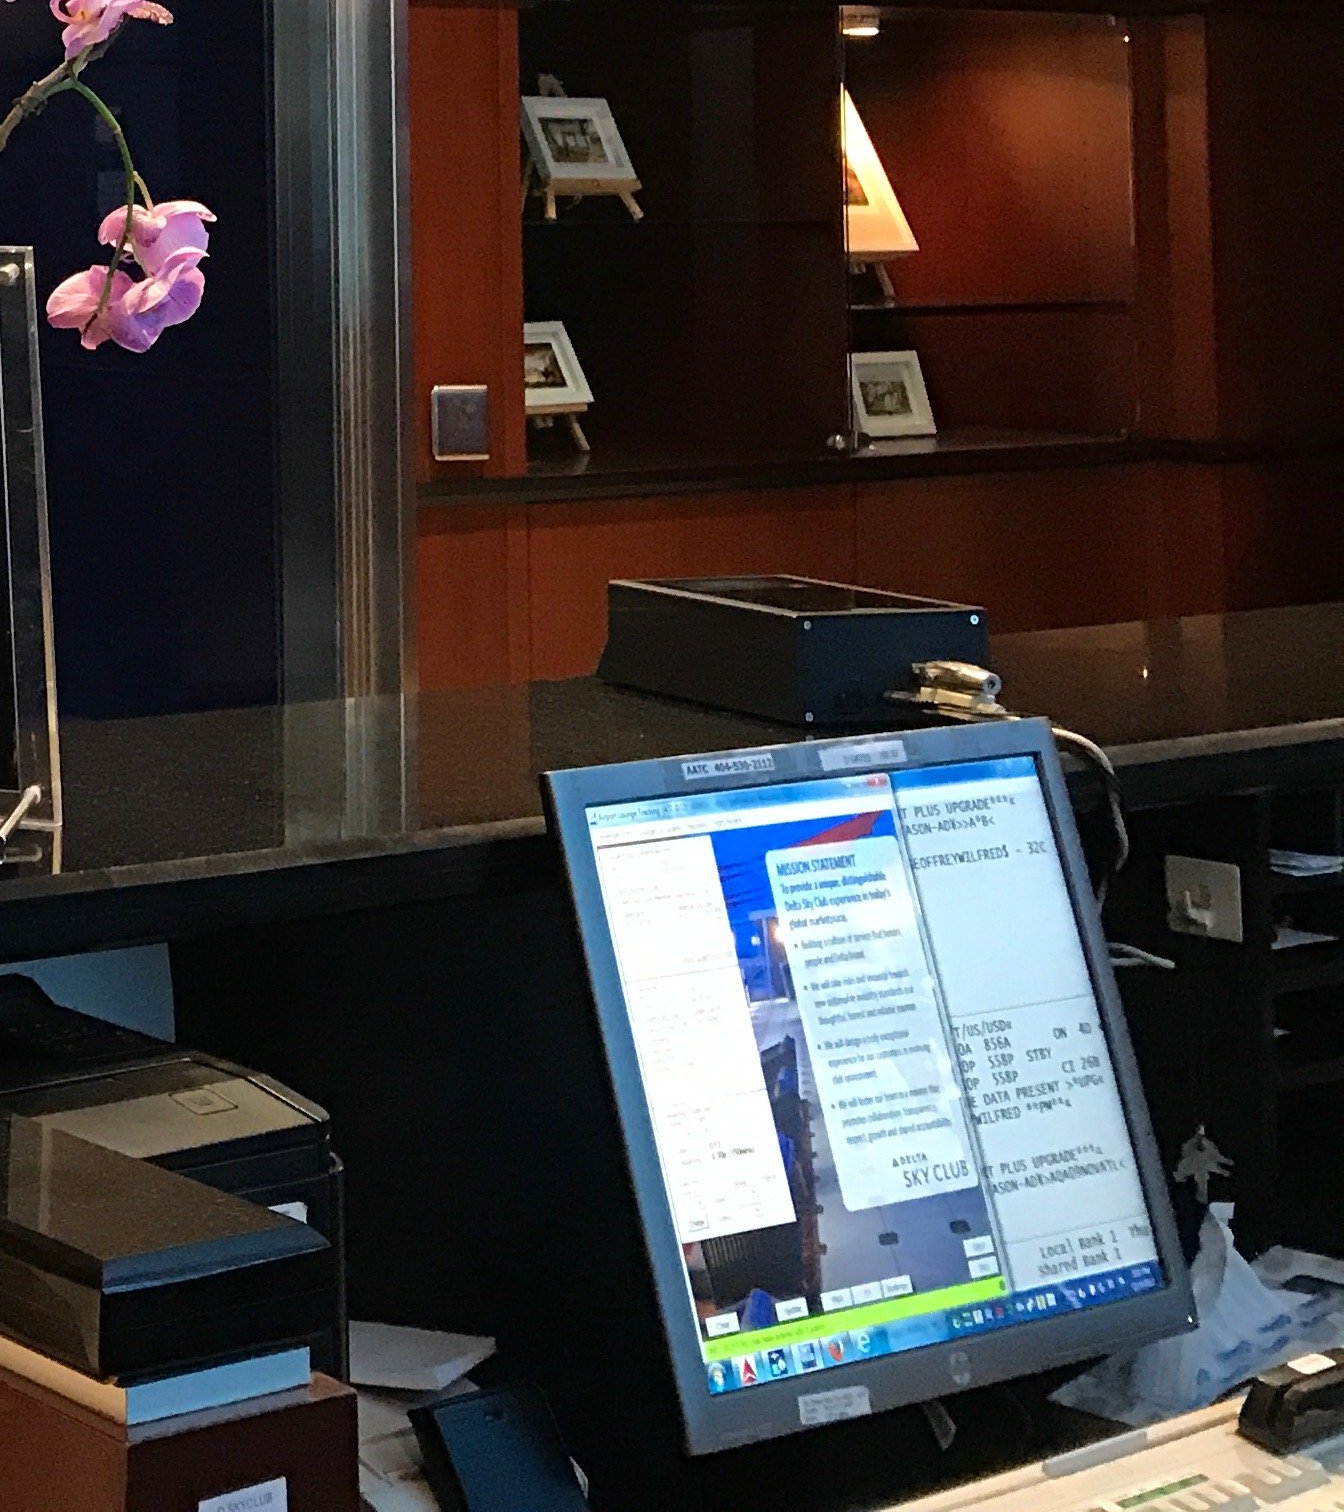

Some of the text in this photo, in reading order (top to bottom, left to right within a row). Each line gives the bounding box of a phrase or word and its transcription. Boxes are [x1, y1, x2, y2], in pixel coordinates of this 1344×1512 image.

[913, 804, 942, 818] PLUS
[776, 859, 811, 876] MISSION
[1025, 1047, 1053, 1062] STBY
[983, 1090, 1011, 1107] DATA
[1015, 1080, 1061, 1100] PRESENT
[899, 1151, 928, 1165] DELTA
[903, 1165, 930, 1188] SKY
[932, 1159, 969, 1182] CLUB
